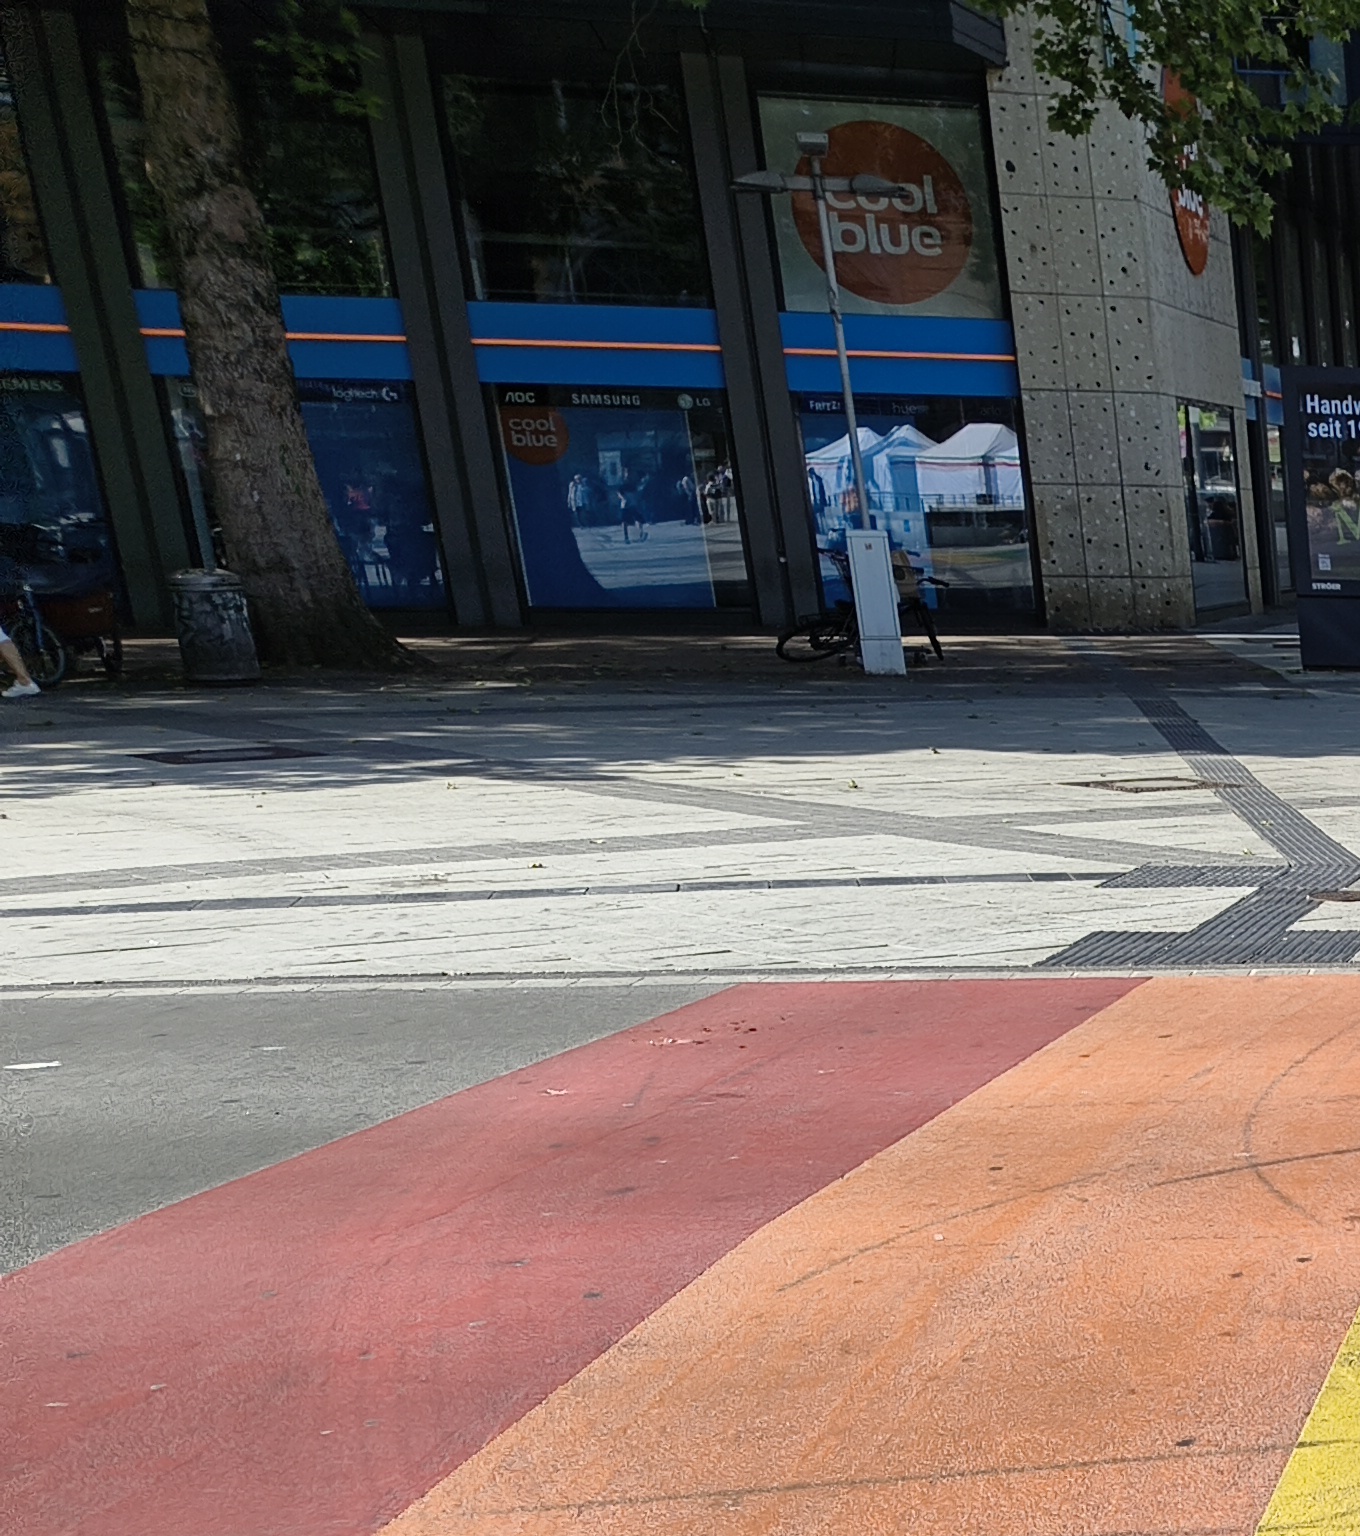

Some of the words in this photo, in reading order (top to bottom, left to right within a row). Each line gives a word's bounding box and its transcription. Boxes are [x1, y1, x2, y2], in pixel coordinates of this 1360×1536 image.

[829, 211, 943, 256] blue
[571, 393, 641, 406] SAMSUNG
[508, 415, 556, 432] cool
[1308, 418, 1342, 438] seit
[511, 431, 557, 448] blue
